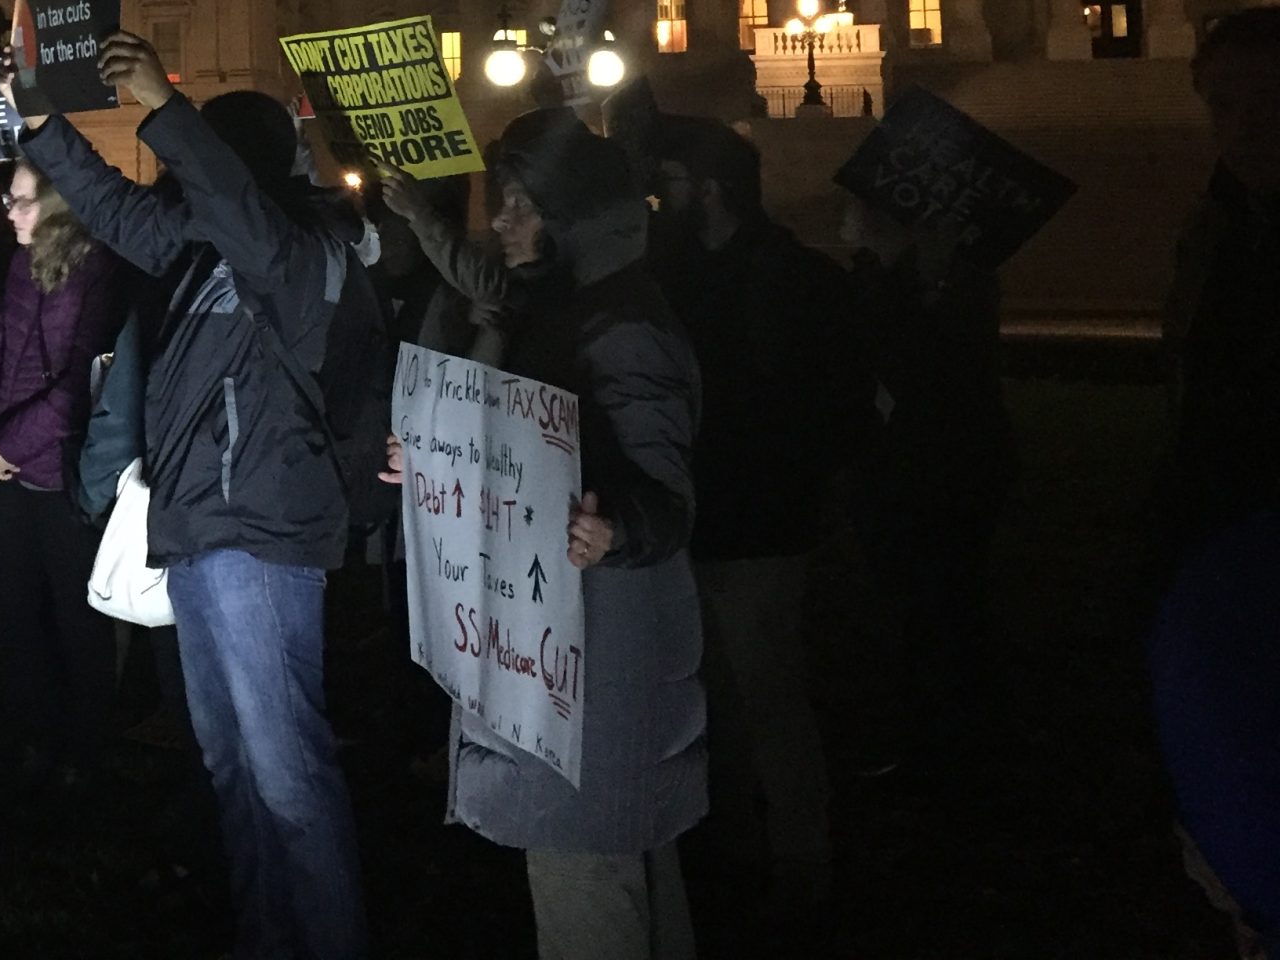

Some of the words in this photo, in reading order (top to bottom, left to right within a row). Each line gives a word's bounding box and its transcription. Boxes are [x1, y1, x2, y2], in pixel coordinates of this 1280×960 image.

[36, 7, 48, 30] in
[48, 8, 66, 28] tax
[66, 0, 91, 24] cuts
[40, 42, 56, 65] for
[56, 39, 74, 62] the
[75, 33, 98, 59] rich
[289, 40, 336, 74] DON'T
[334, 34, 370, 72] CUT
[368, 24, 435, 67] TAXES
[326, 62, 448, 108] CORPORATIONS
[355, 112, 395, 141] SEND
[398, 105, 444, 138] JOBS
[364, 130, 472, 168] SHORE
[437, 358, 481, 404] Trickle
[502, 378, 536, 420] TAX
[538, 385, 579, 434] SCAM
[430, 437, 463, 467] aways
[468, 436, 480, 464] to
[414, 472, 447, 516] Debt
[432, 536, 469, 582] Your
[454, 602, 482, 658] SS
[486, 616, 537, 678] Medicare
[540, 626, 582, 702] CUT
